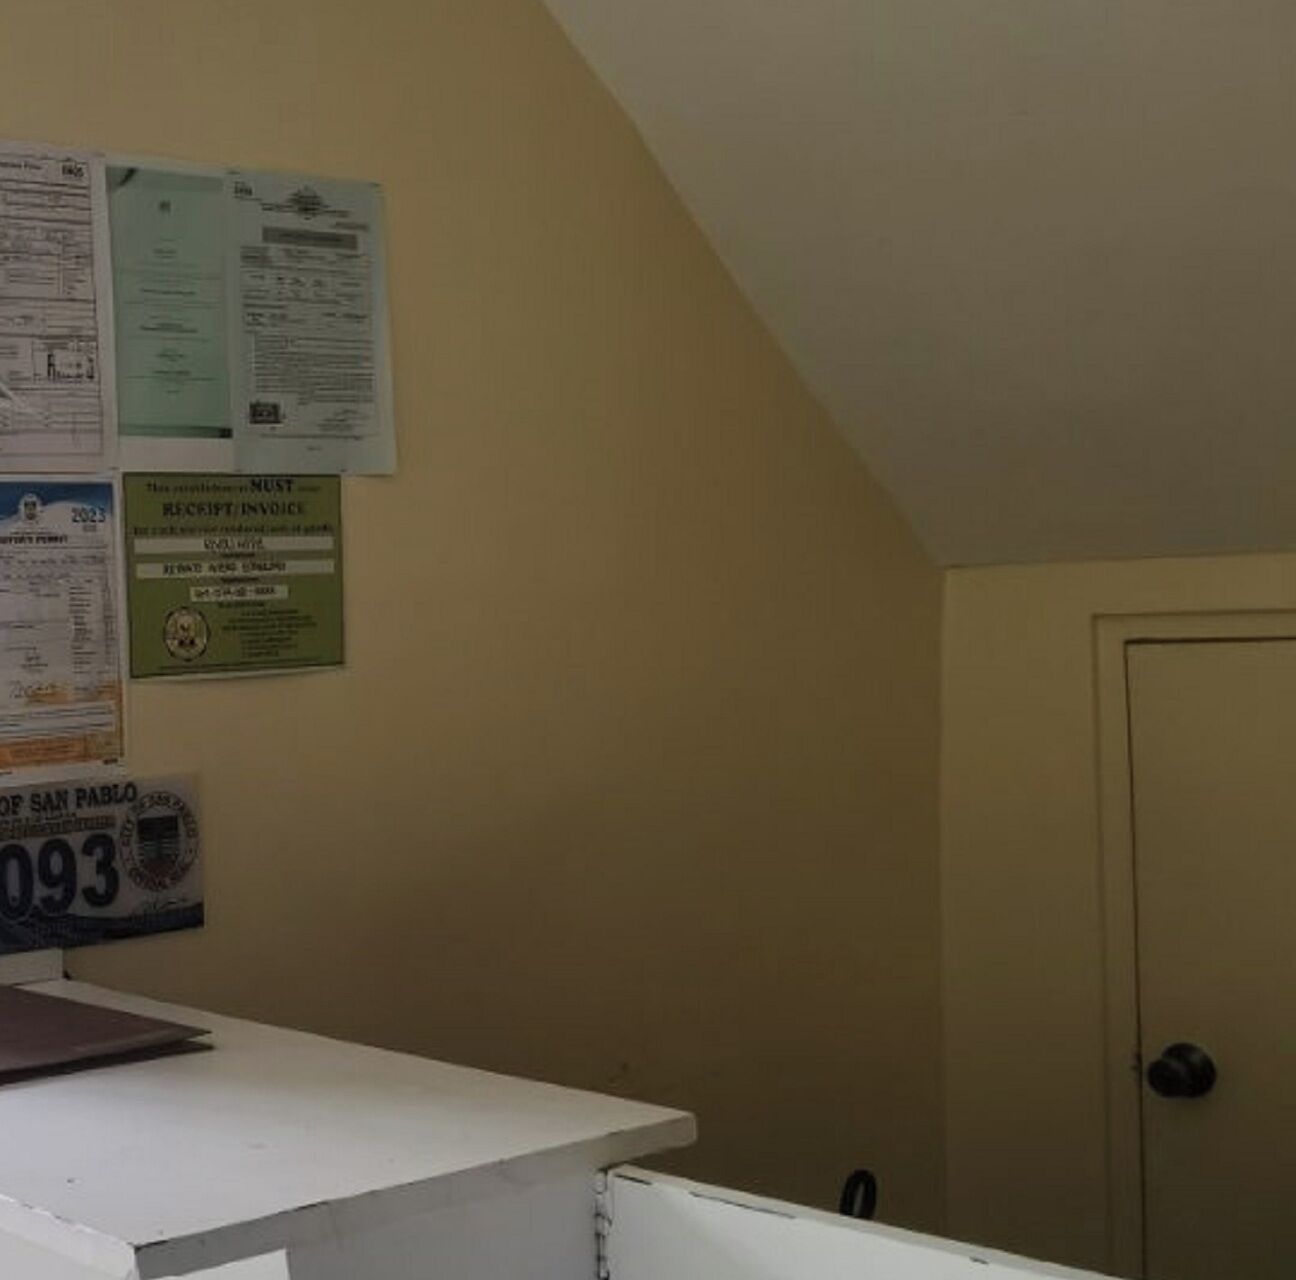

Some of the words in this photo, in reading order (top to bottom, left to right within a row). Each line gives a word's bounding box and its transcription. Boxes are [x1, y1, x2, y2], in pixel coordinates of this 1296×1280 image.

[250, 479, 295, 493] MUST
[71, 506, 106, 522] 2023
[31, 789, 69, 813] SAN
[75, 782, 137, 809] PABLO
